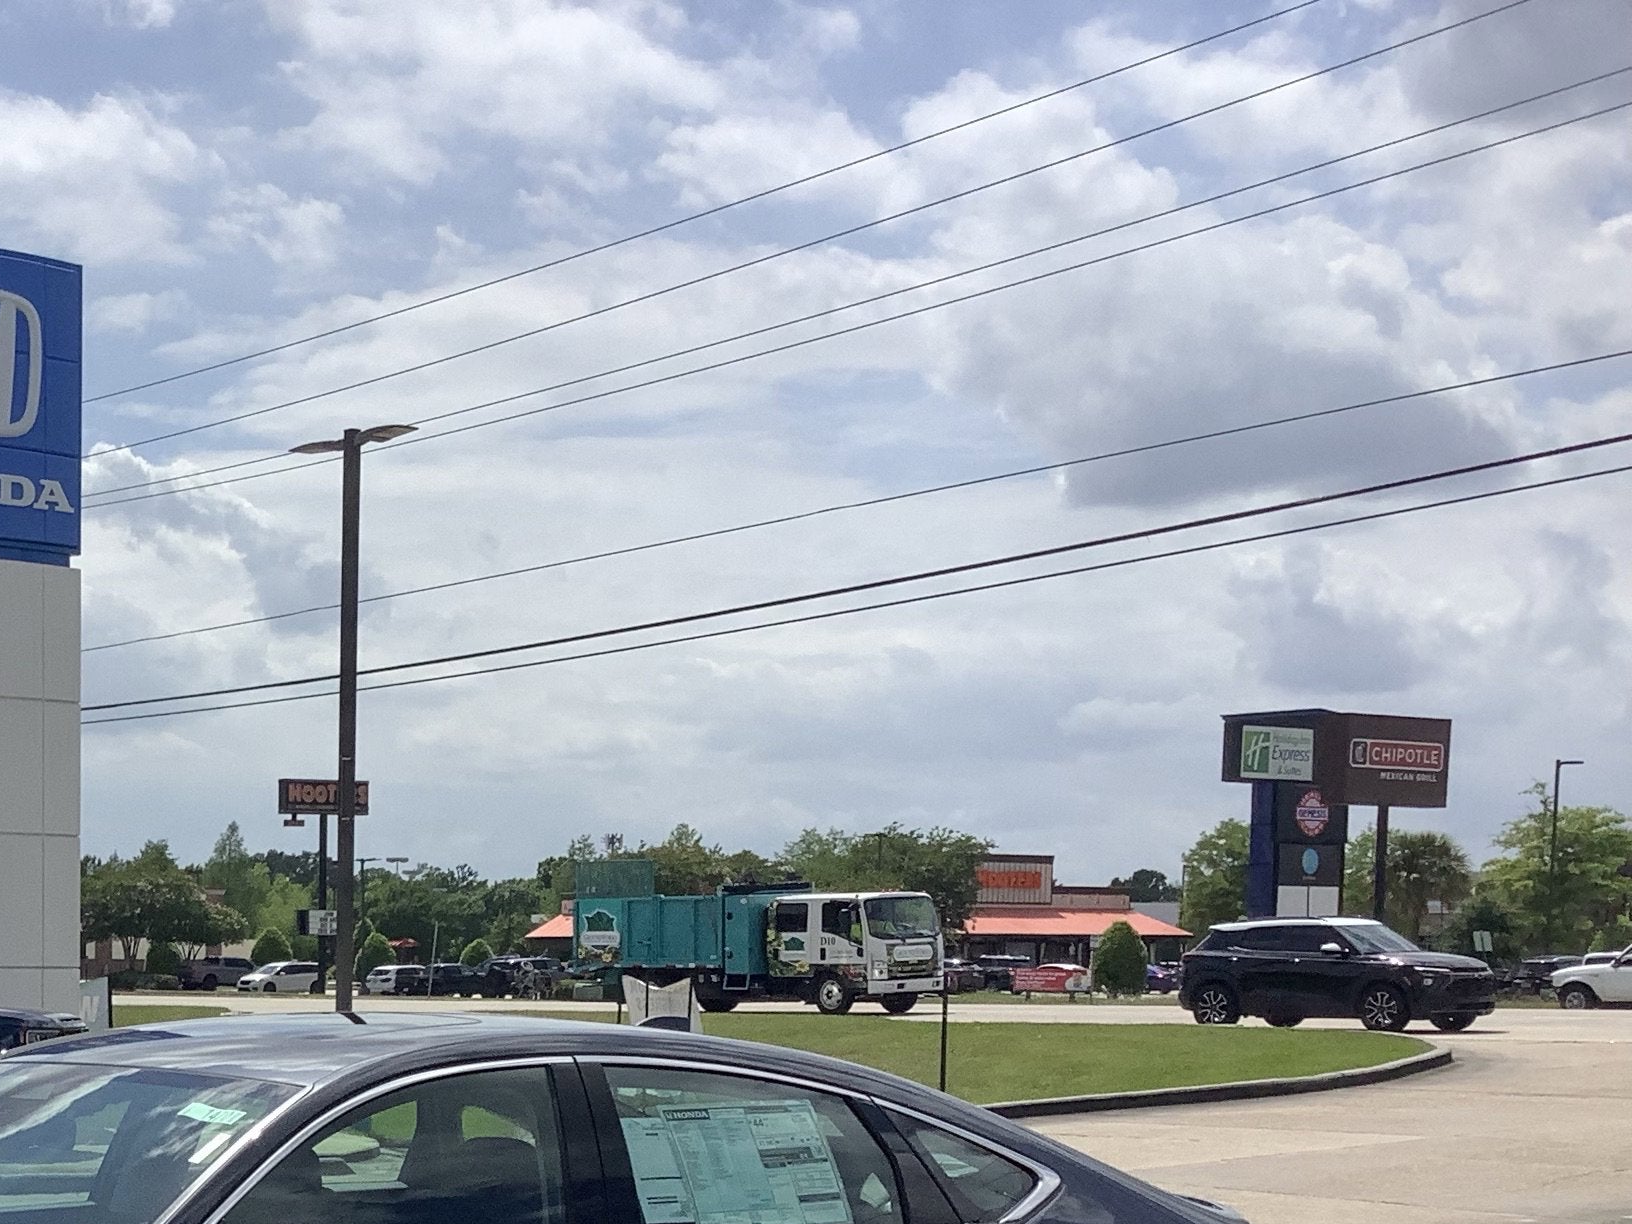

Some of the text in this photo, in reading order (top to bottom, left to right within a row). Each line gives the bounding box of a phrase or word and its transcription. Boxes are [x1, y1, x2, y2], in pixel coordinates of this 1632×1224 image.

[1272, 745, 1310, 764] Express
[1371, 746, 1439, 764] CHIPOTLE
[1380, 771, 1414, 781] MEXICAN
[288, 782, 367, 805] HOOTS
[820, 937, 836, 946] D10
[673, 1111, 709, 1119] HONDA
